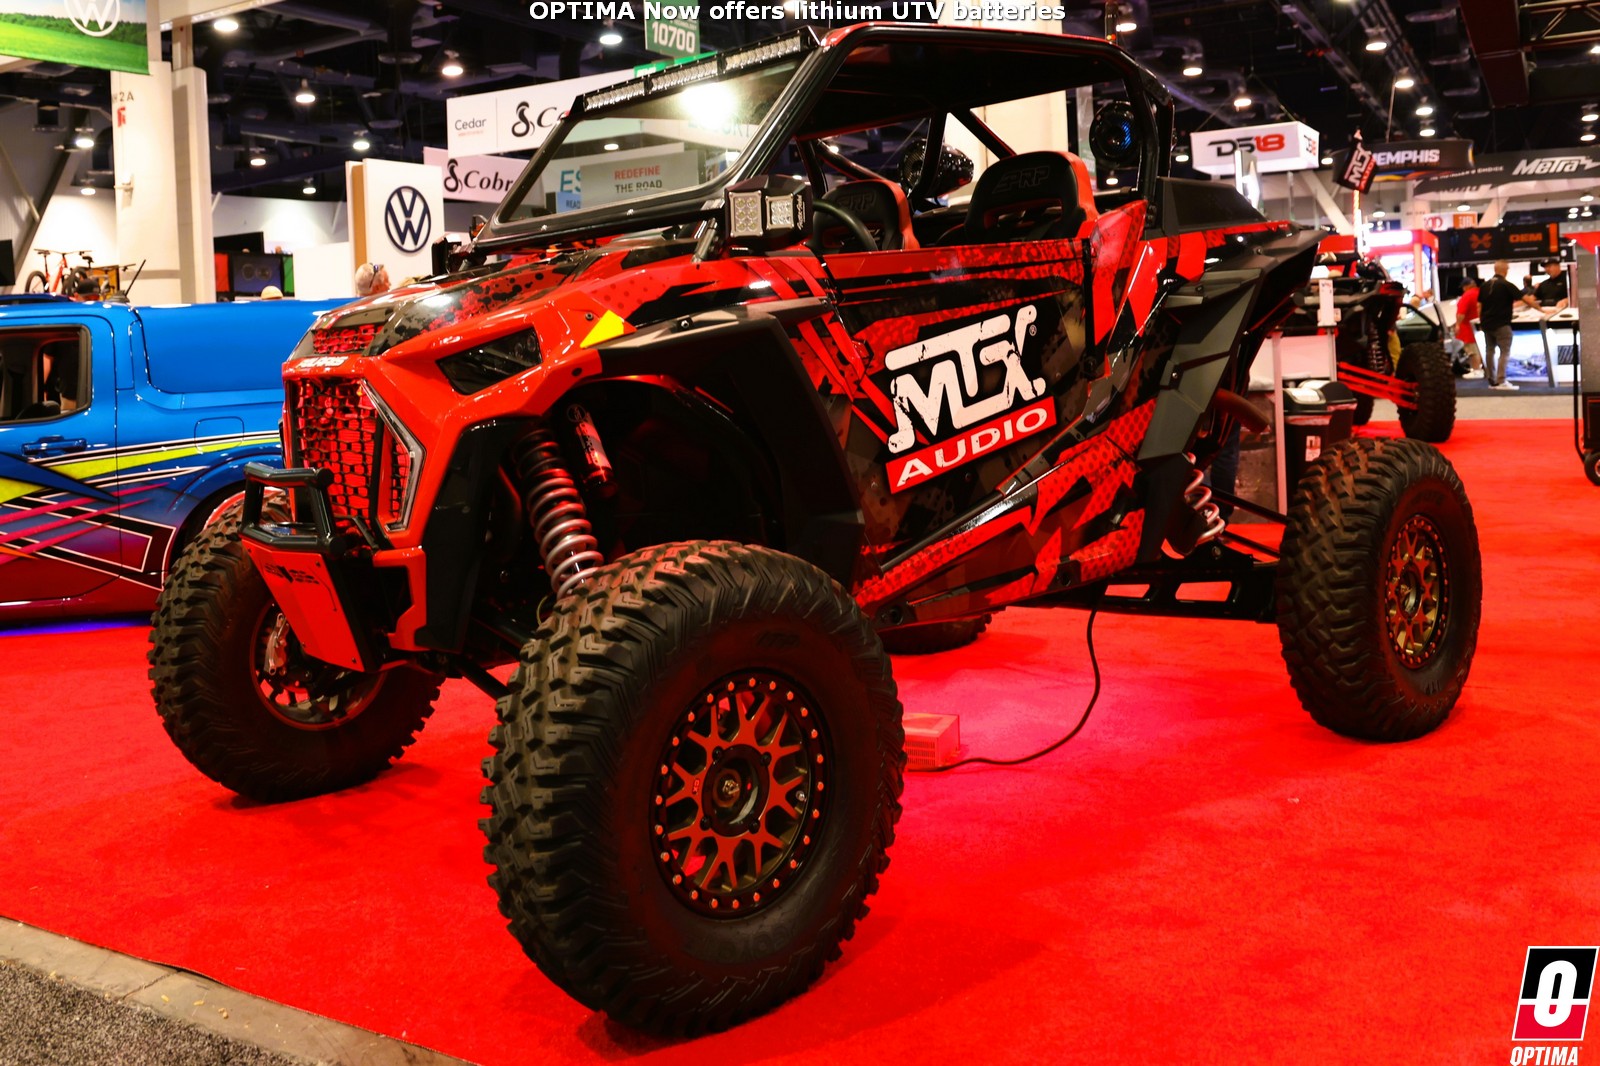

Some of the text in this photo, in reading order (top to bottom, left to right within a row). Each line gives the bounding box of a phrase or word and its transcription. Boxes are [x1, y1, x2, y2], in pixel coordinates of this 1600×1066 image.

[652, 21, 696, 53] 10700
[455, 117, 487, 131] Cedar
[1208, 133, 1285, 157] DS18
[614, 165, 661, 180] REDEFINE
[1344, 142, 1371, 187] MTX
[463, 170, 514, 192] Cobr
[614, 179, 663, 194] THE ROAD
[885, 304, 1046, 454] MTX
[896, 407, 1049, 487] AUDIO
